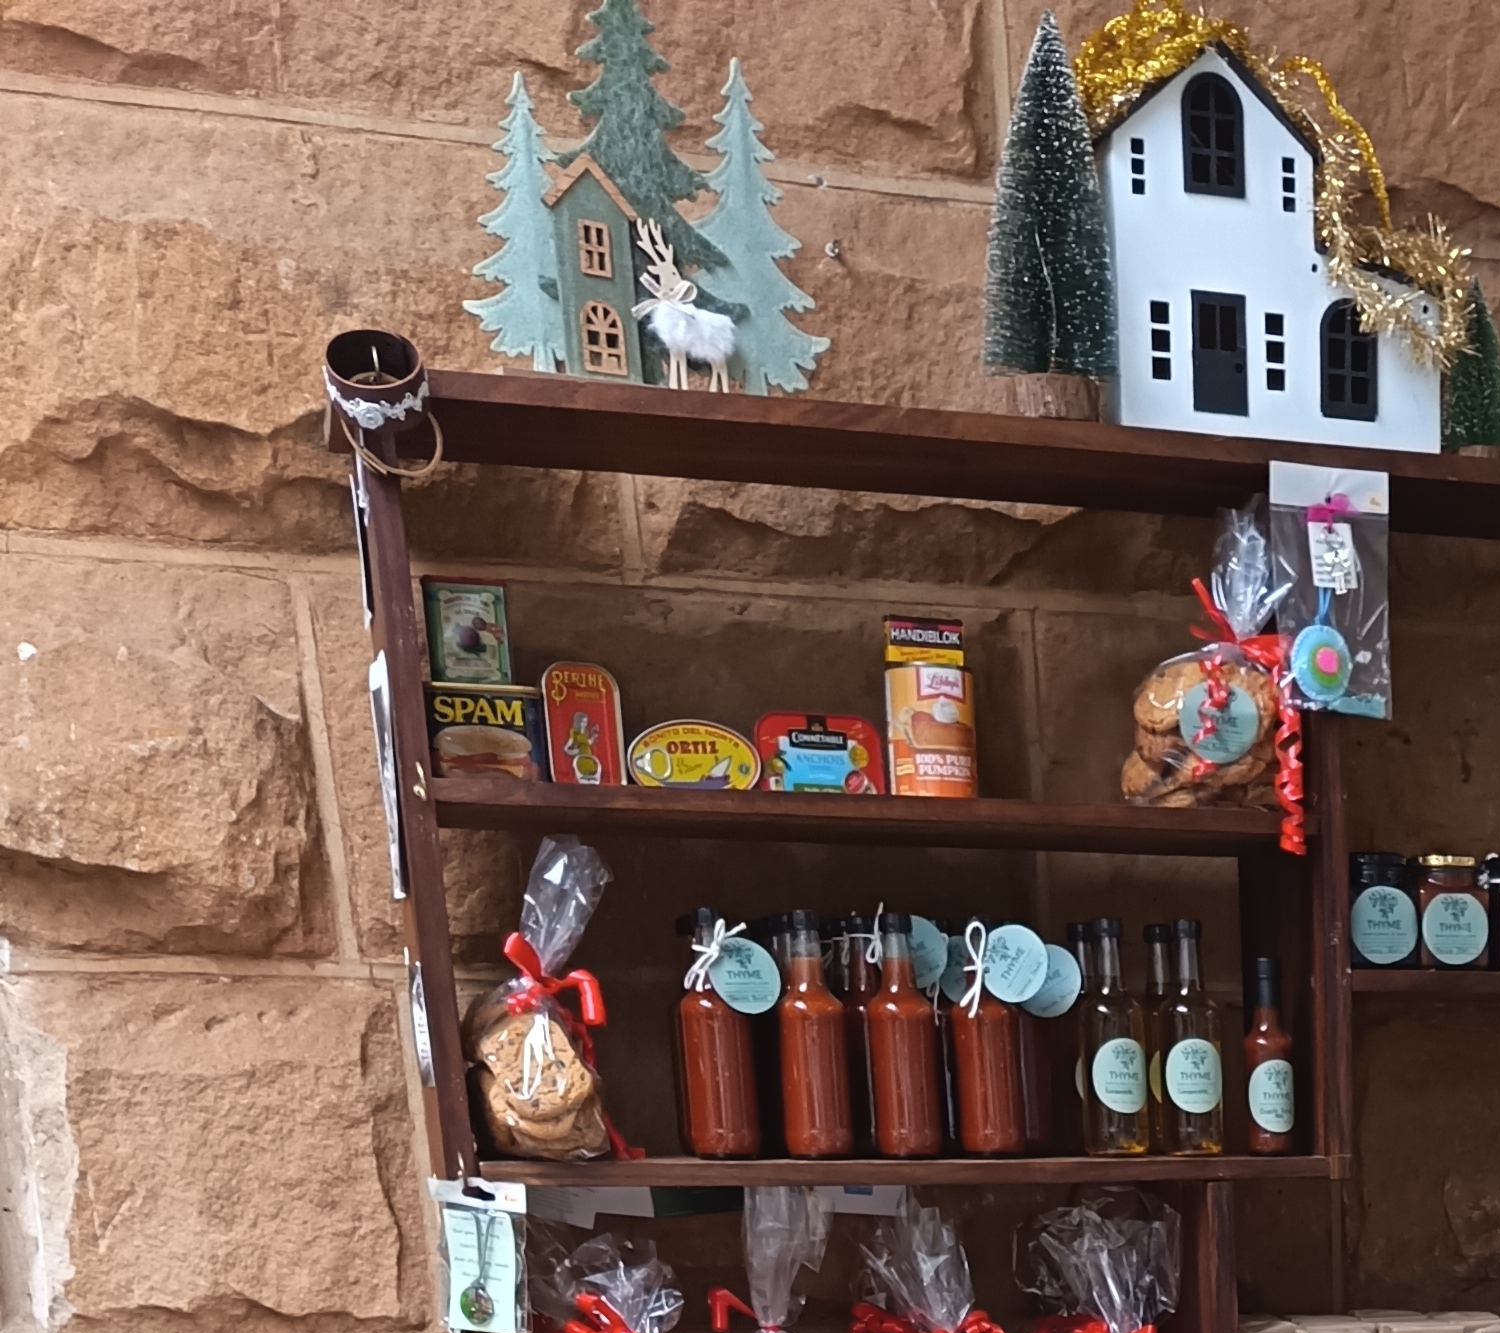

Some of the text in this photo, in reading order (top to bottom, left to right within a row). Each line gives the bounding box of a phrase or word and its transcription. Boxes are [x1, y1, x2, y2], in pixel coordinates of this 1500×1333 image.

[433, 695, 524, 727] SPAM
[666, 740, 719, 756] ORTIZ
[1367, 919, 1402, 931] THYME
[1439, 922, 1472, 933] THYME
[1000, 946, 1027, 981] THYME
[725, 969, 764, 980] THYME
[1109, 1070, 1140, 1082] THYME
[1180, 1071, 1212, 1082] THYME
[1262, 1091, 1292, 1101] THYME
